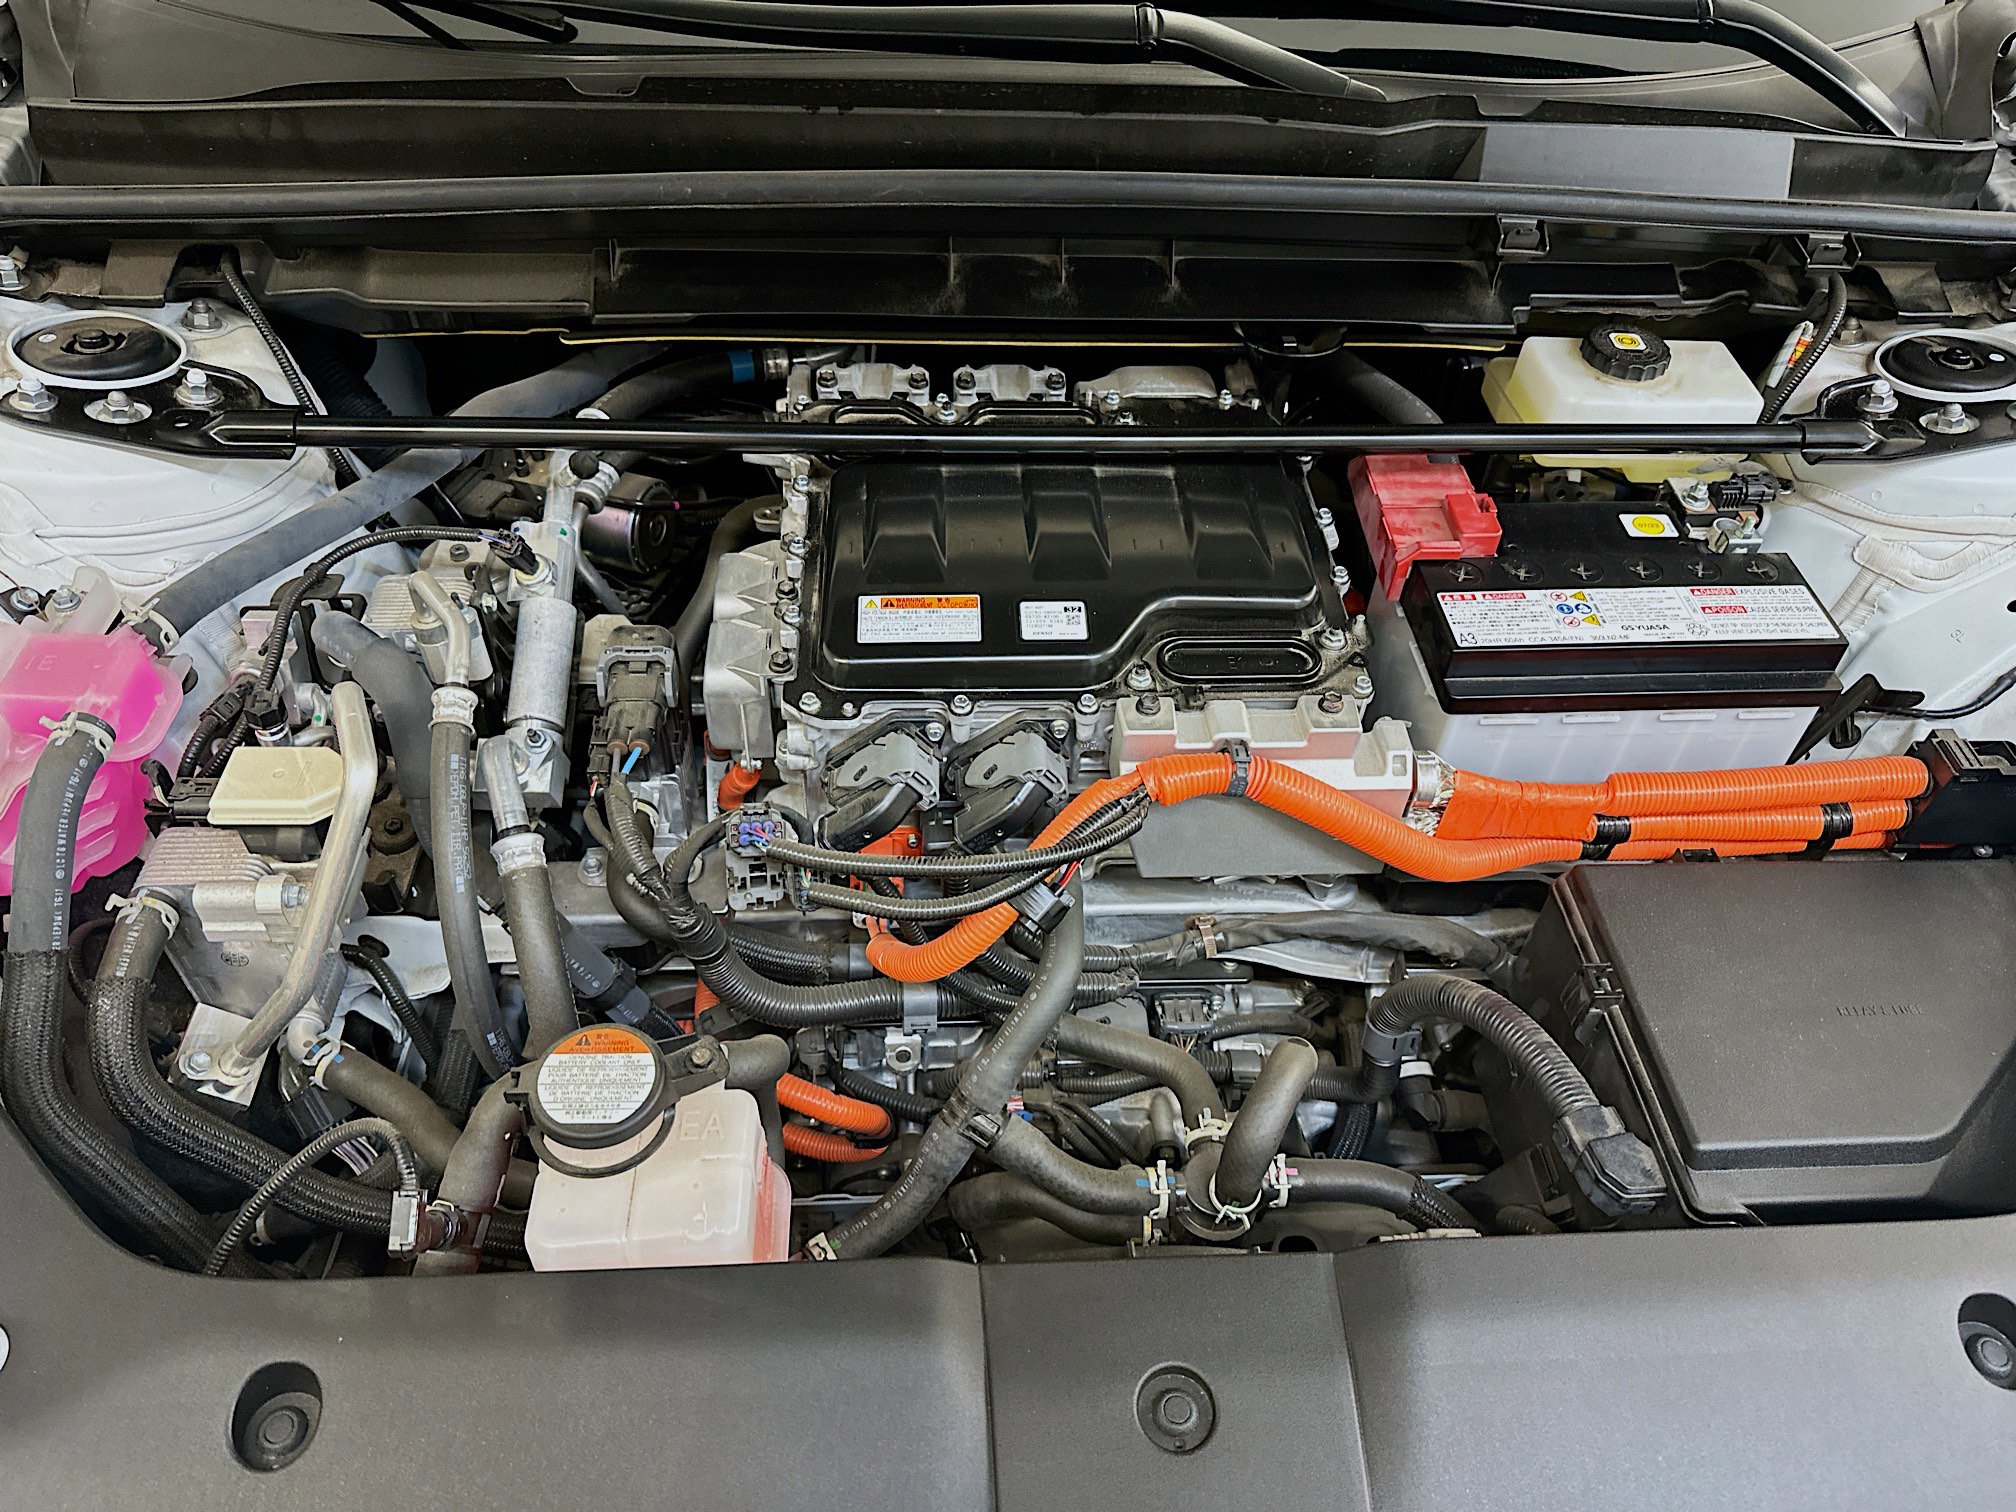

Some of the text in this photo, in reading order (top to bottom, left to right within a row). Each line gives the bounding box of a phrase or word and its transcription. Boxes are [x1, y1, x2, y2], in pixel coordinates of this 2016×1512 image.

[1736, 588, 1776, 596] EXPLOSIVE
[1712, 606, 1744, 614] POISON
[1460, 632, 1478, 645] A3
